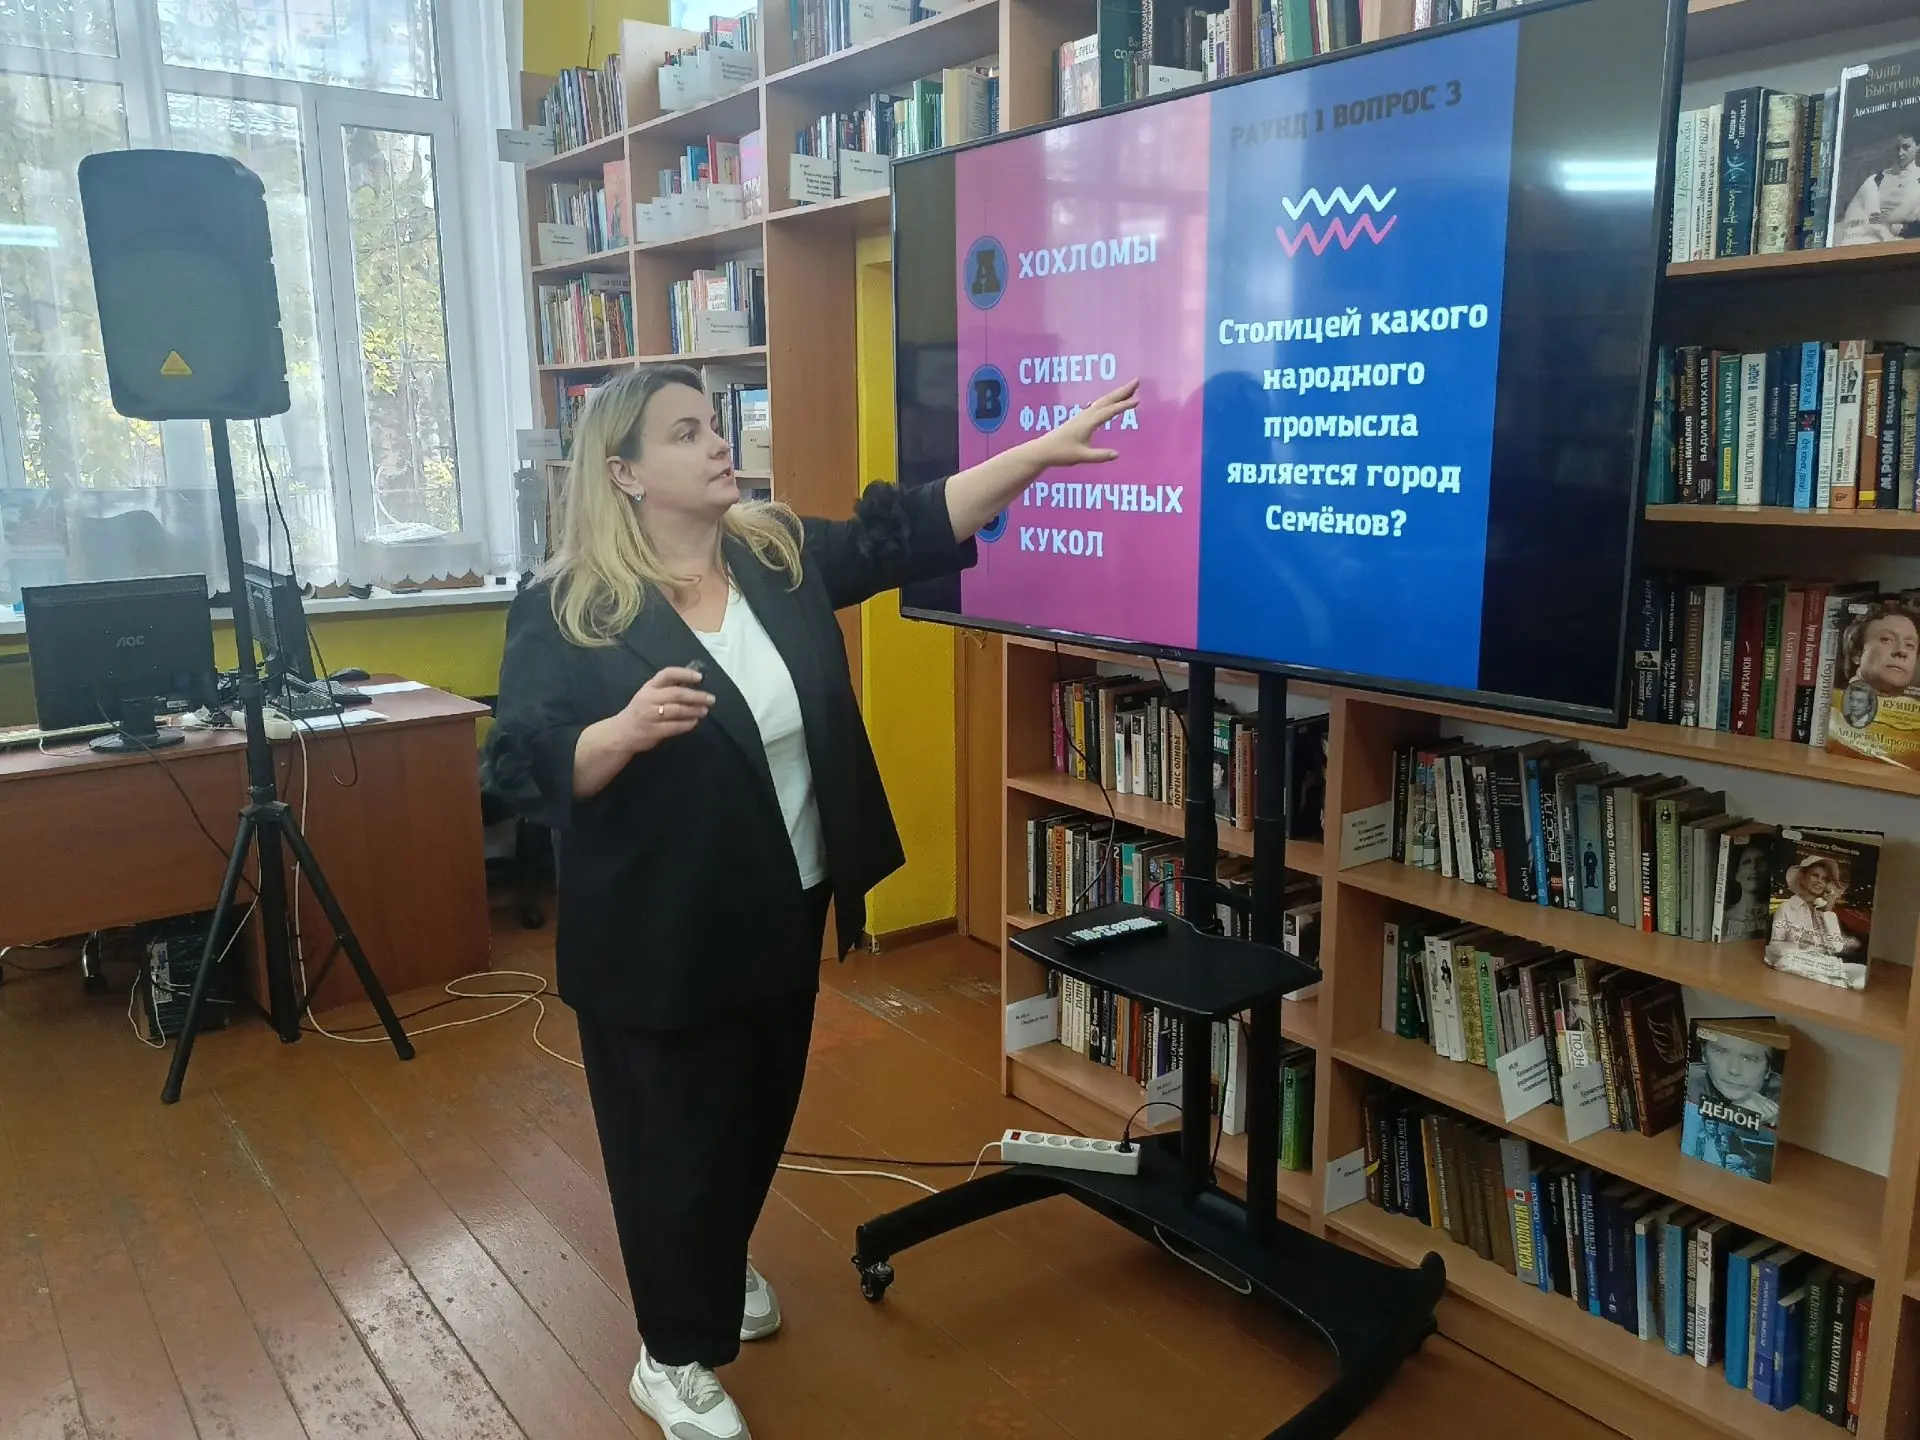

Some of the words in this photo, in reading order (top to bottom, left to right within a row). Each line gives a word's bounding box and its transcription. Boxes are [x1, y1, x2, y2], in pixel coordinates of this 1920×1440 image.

[1230, 113, 1307, 148] РАУНД
[1316, 109, 1324, 131] 1
[1333, 84, 1436, 127] ВОПРОС
[1445, 80, 1461, 106] 3
[1018, 234, 1157, 279] ХОХЛОМЫ
[1219, 307, 1361, 345] Столицей
[1371, 304, 1488, 335] какого
[1019, 353, 1116, 384] СИНЕГО
[1263, 361, 1425, 395] народного
[1700, 358, 1708, 416] МИХАЛЕВ
[1019, 405, 1138, 431] ФАРА
[1264, 414, 1418, 444] промысла
[1700, 419, 1708, 461] ВАДИМ
[1227, 462, 1357, 485] является
[1366, 465, 1461, 494] город
[1022, 482, 1183, 513] ТРЯПИЧНЫХ
[1266, 504, 1407, 537] Семёнов?
[1020, 526, 1103, 557] КУКОЛ
[115, 634, 146, 649] AOC
[1543, 793, 1552, 814] ЛИ
[1605, 795, 1614, 838] Феллини
[1546, 819, 1556, 862] БРЮС
[1607, 848, 1616, 891] Феллини
[1699, 1098, 1760, 1131] ДЕЛОН
[1514, 1203, 1533, 1270] ПСИХОЛОГИЯ
[1829, 1321, 1843, 1393] ПСИХОЛОГИЯ
